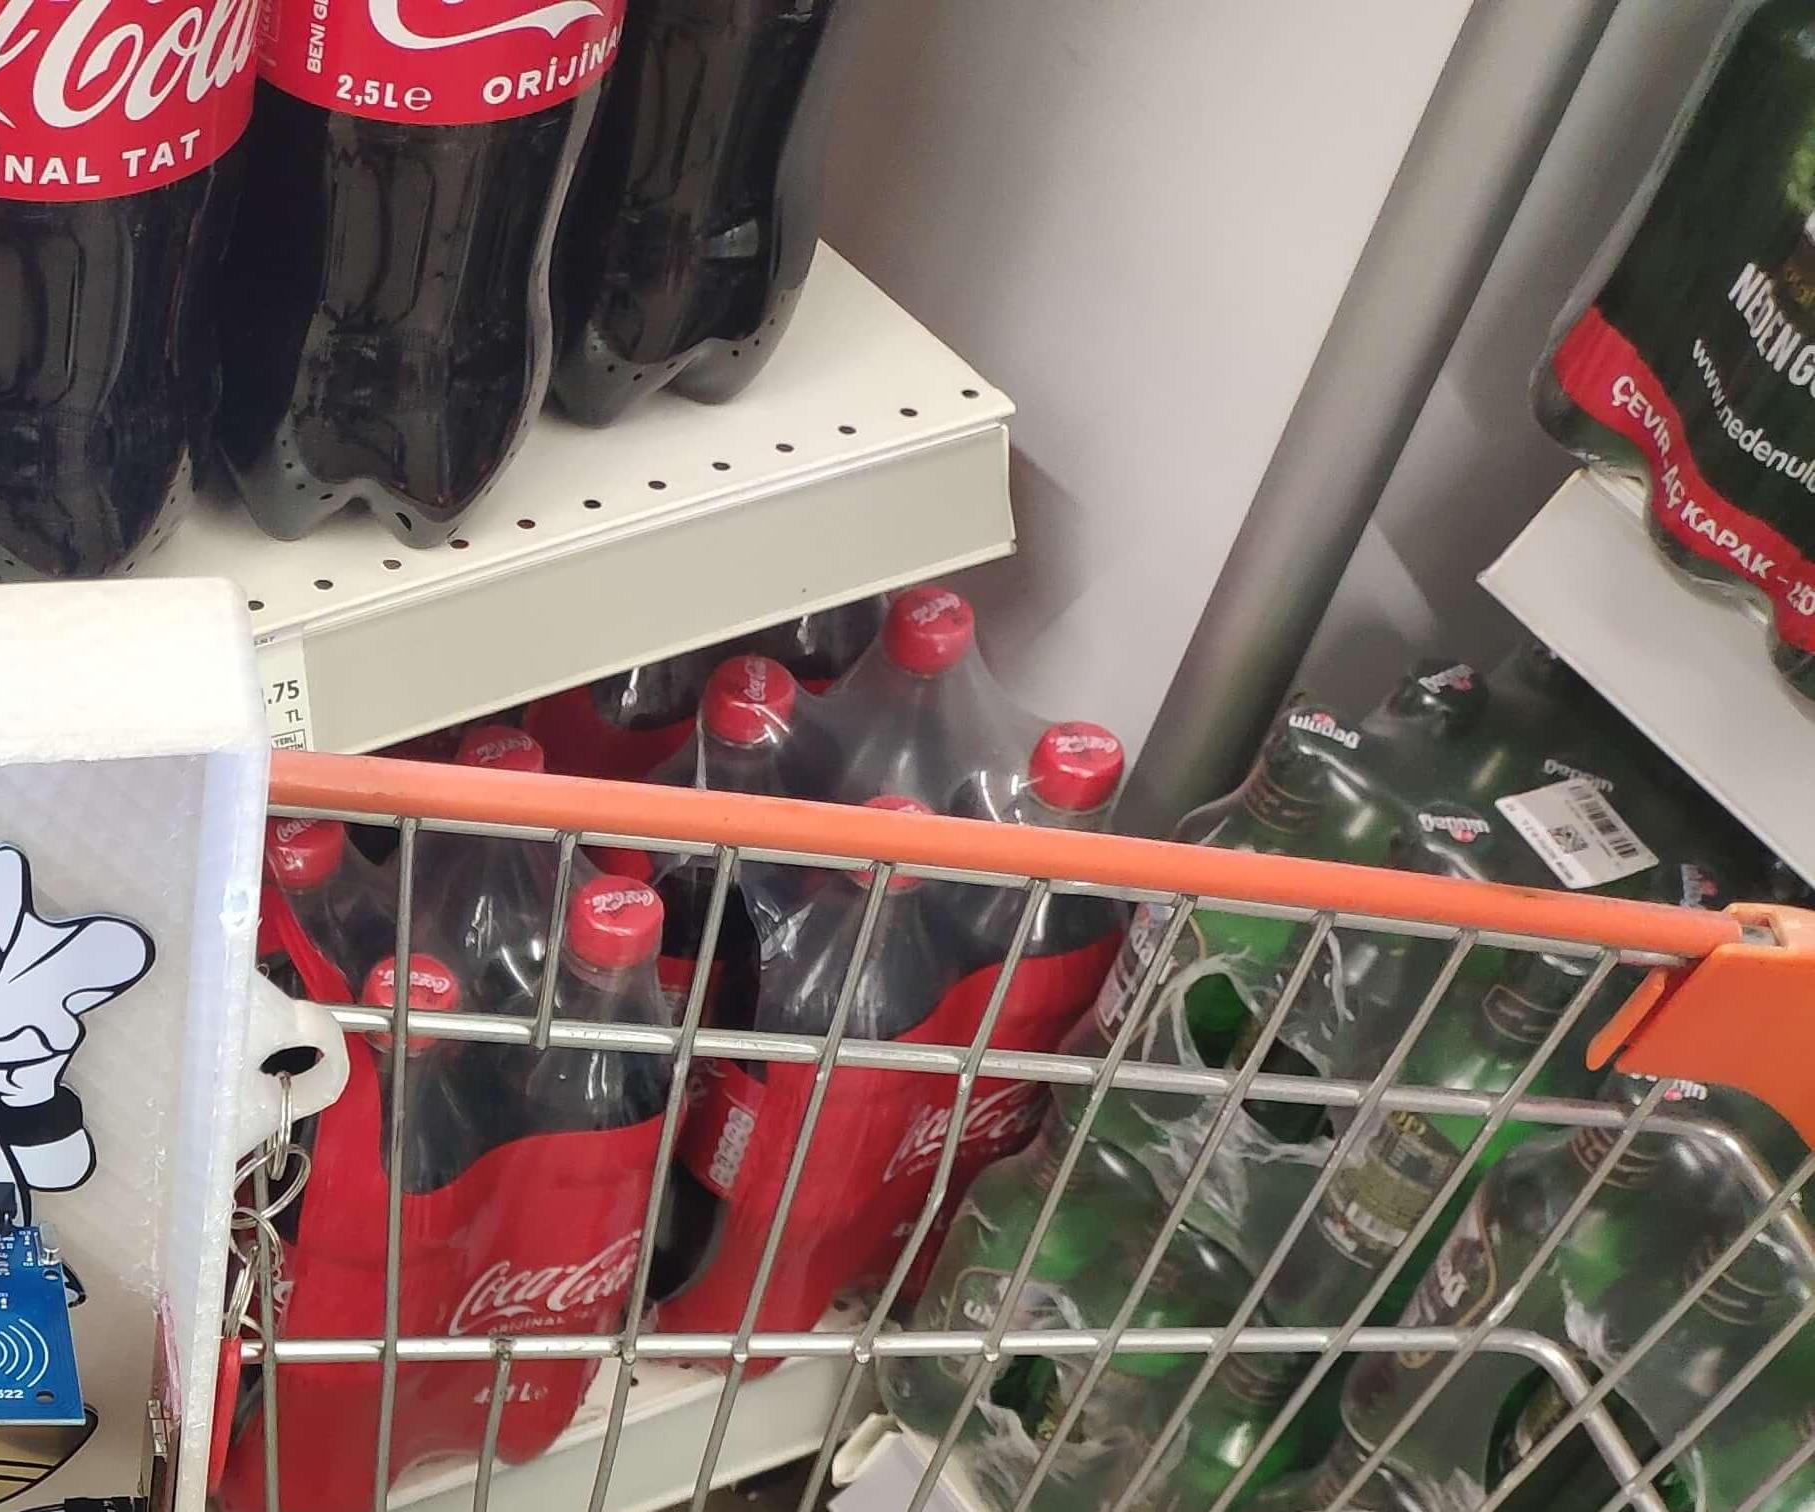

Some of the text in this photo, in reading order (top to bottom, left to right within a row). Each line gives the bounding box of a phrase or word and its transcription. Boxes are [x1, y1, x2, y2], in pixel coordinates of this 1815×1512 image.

[122, 129, 201, 178] TAT
[1680, 499, 1775, 580] KAPAK
[262, 679, 301, 705] .75
[284, 708, 304, 723] TL
